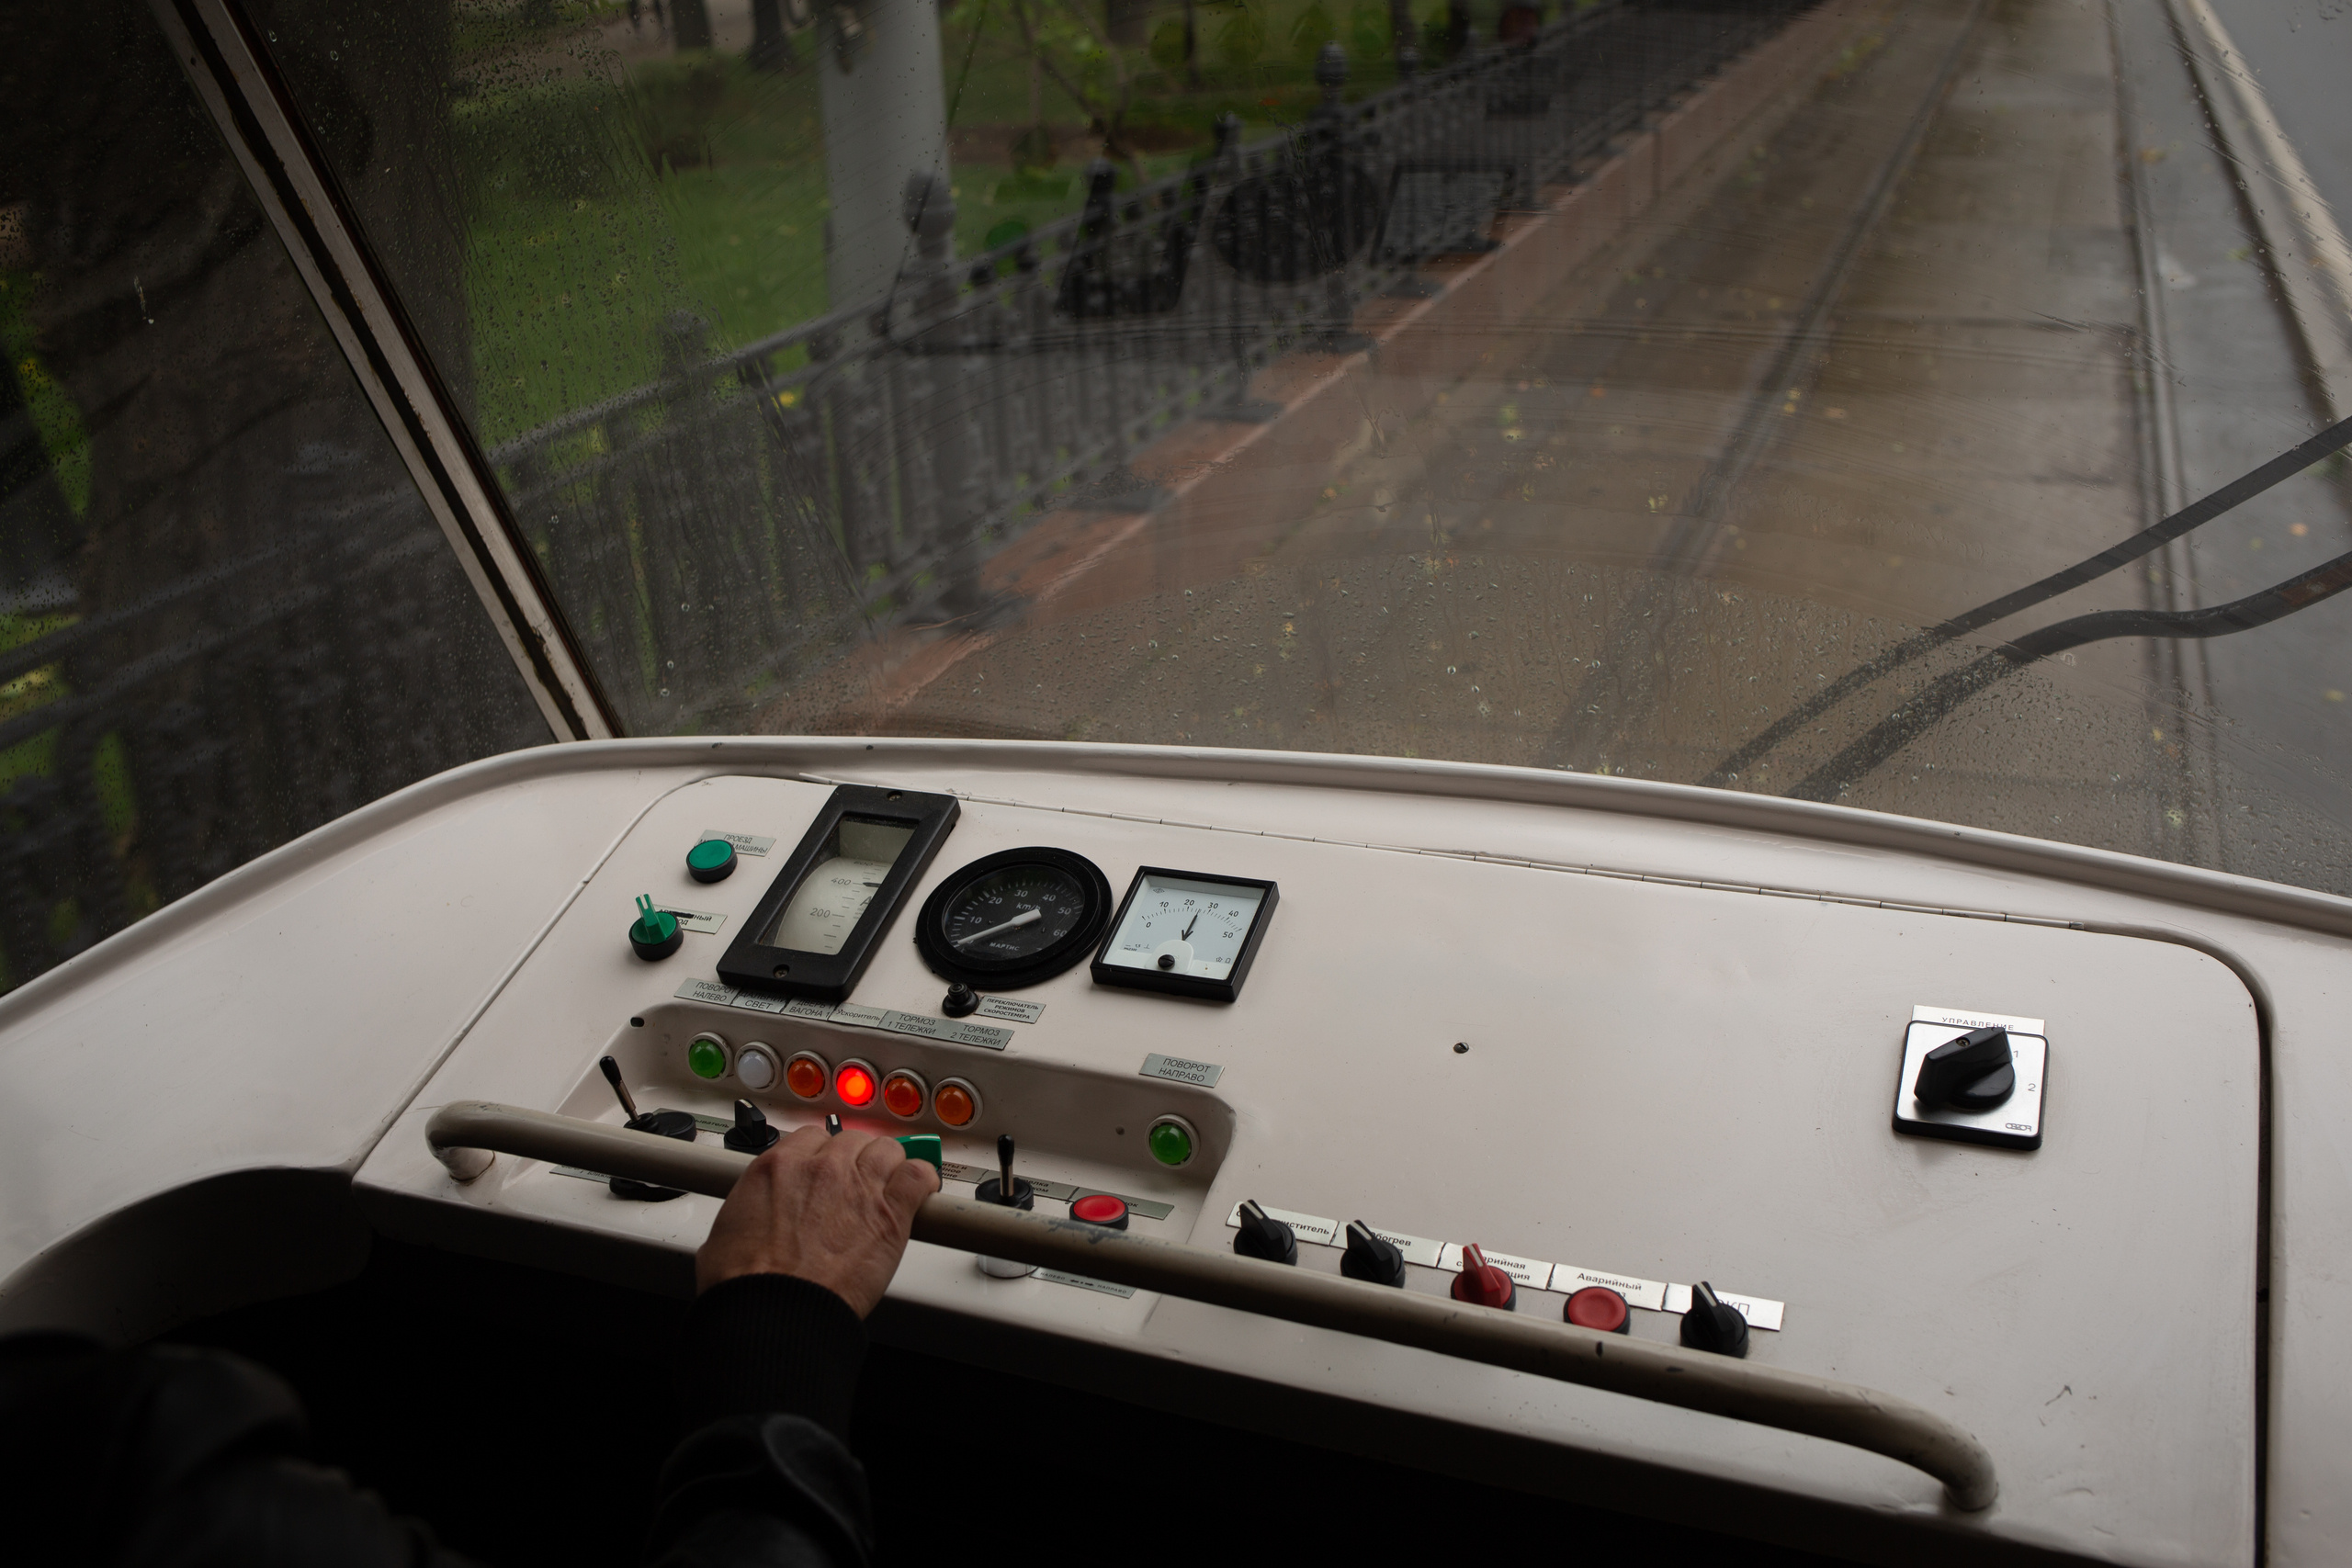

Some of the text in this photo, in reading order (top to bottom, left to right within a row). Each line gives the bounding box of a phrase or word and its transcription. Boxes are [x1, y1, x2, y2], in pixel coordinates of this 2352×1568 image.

[723, 834, 753, 844] ПРОЕЗД
[734, 843, 769, 853] МАШИНЫ
[831, 877, 852, 886] 400
[1014, 889, 1028, 897] 30
[1042, 894, 1057, 902] 40
[988, 897, 1003, 905] 20
[1016, 902, 1041, 910] km/h
[809, 907, 831, 919] 200
[1057, 907, 1072, 915] 50
[969, 916, 982, 924] 10
[1053, 929, 1067, 937] 60
[695, 981, 735, 995] ПОВОРОТ
[693, 990, 728, 1002] НАЛЕВО
[745, 1000, 773, 1010] СВЕТ
[987, 998, 1039, 1010] ПЕРЕКЛЮЧАТЕЛЬ
[994, 1005, 1025, 1013] РЕЖИМОВ
[789, 1007, 823, 1017] ВАГОНА
[836, 1010, 880, 1021] Ускоритель
[983, 1009, 1030, 1019] СКОРОСТЕМЕРА
[899, 1014, 936, 1025] ТОРМОЗ
[1942, 1017, 2014, 1031] УПРАВЛЕНИЕ
[894, 1021, 936, 1035] ТЕЛЕЖКИ
[963, 1025, 1001, 1036] ТОРМОЗ
[958, 1033, 1001, 1045] ТЕЛЕЖКИ
[2013, 1050, 2018, 1058] 1
[1162, 1058, 1211, 1073] ПОВОРОТ
[1159, 1067, 1204, 1082] НАПРАВО
[2028, 1083, 2036, 1092] 2
[1483, 1256, 1526, 1269] арийная
[1577, 1272, 1642, 1291] Аварийный
